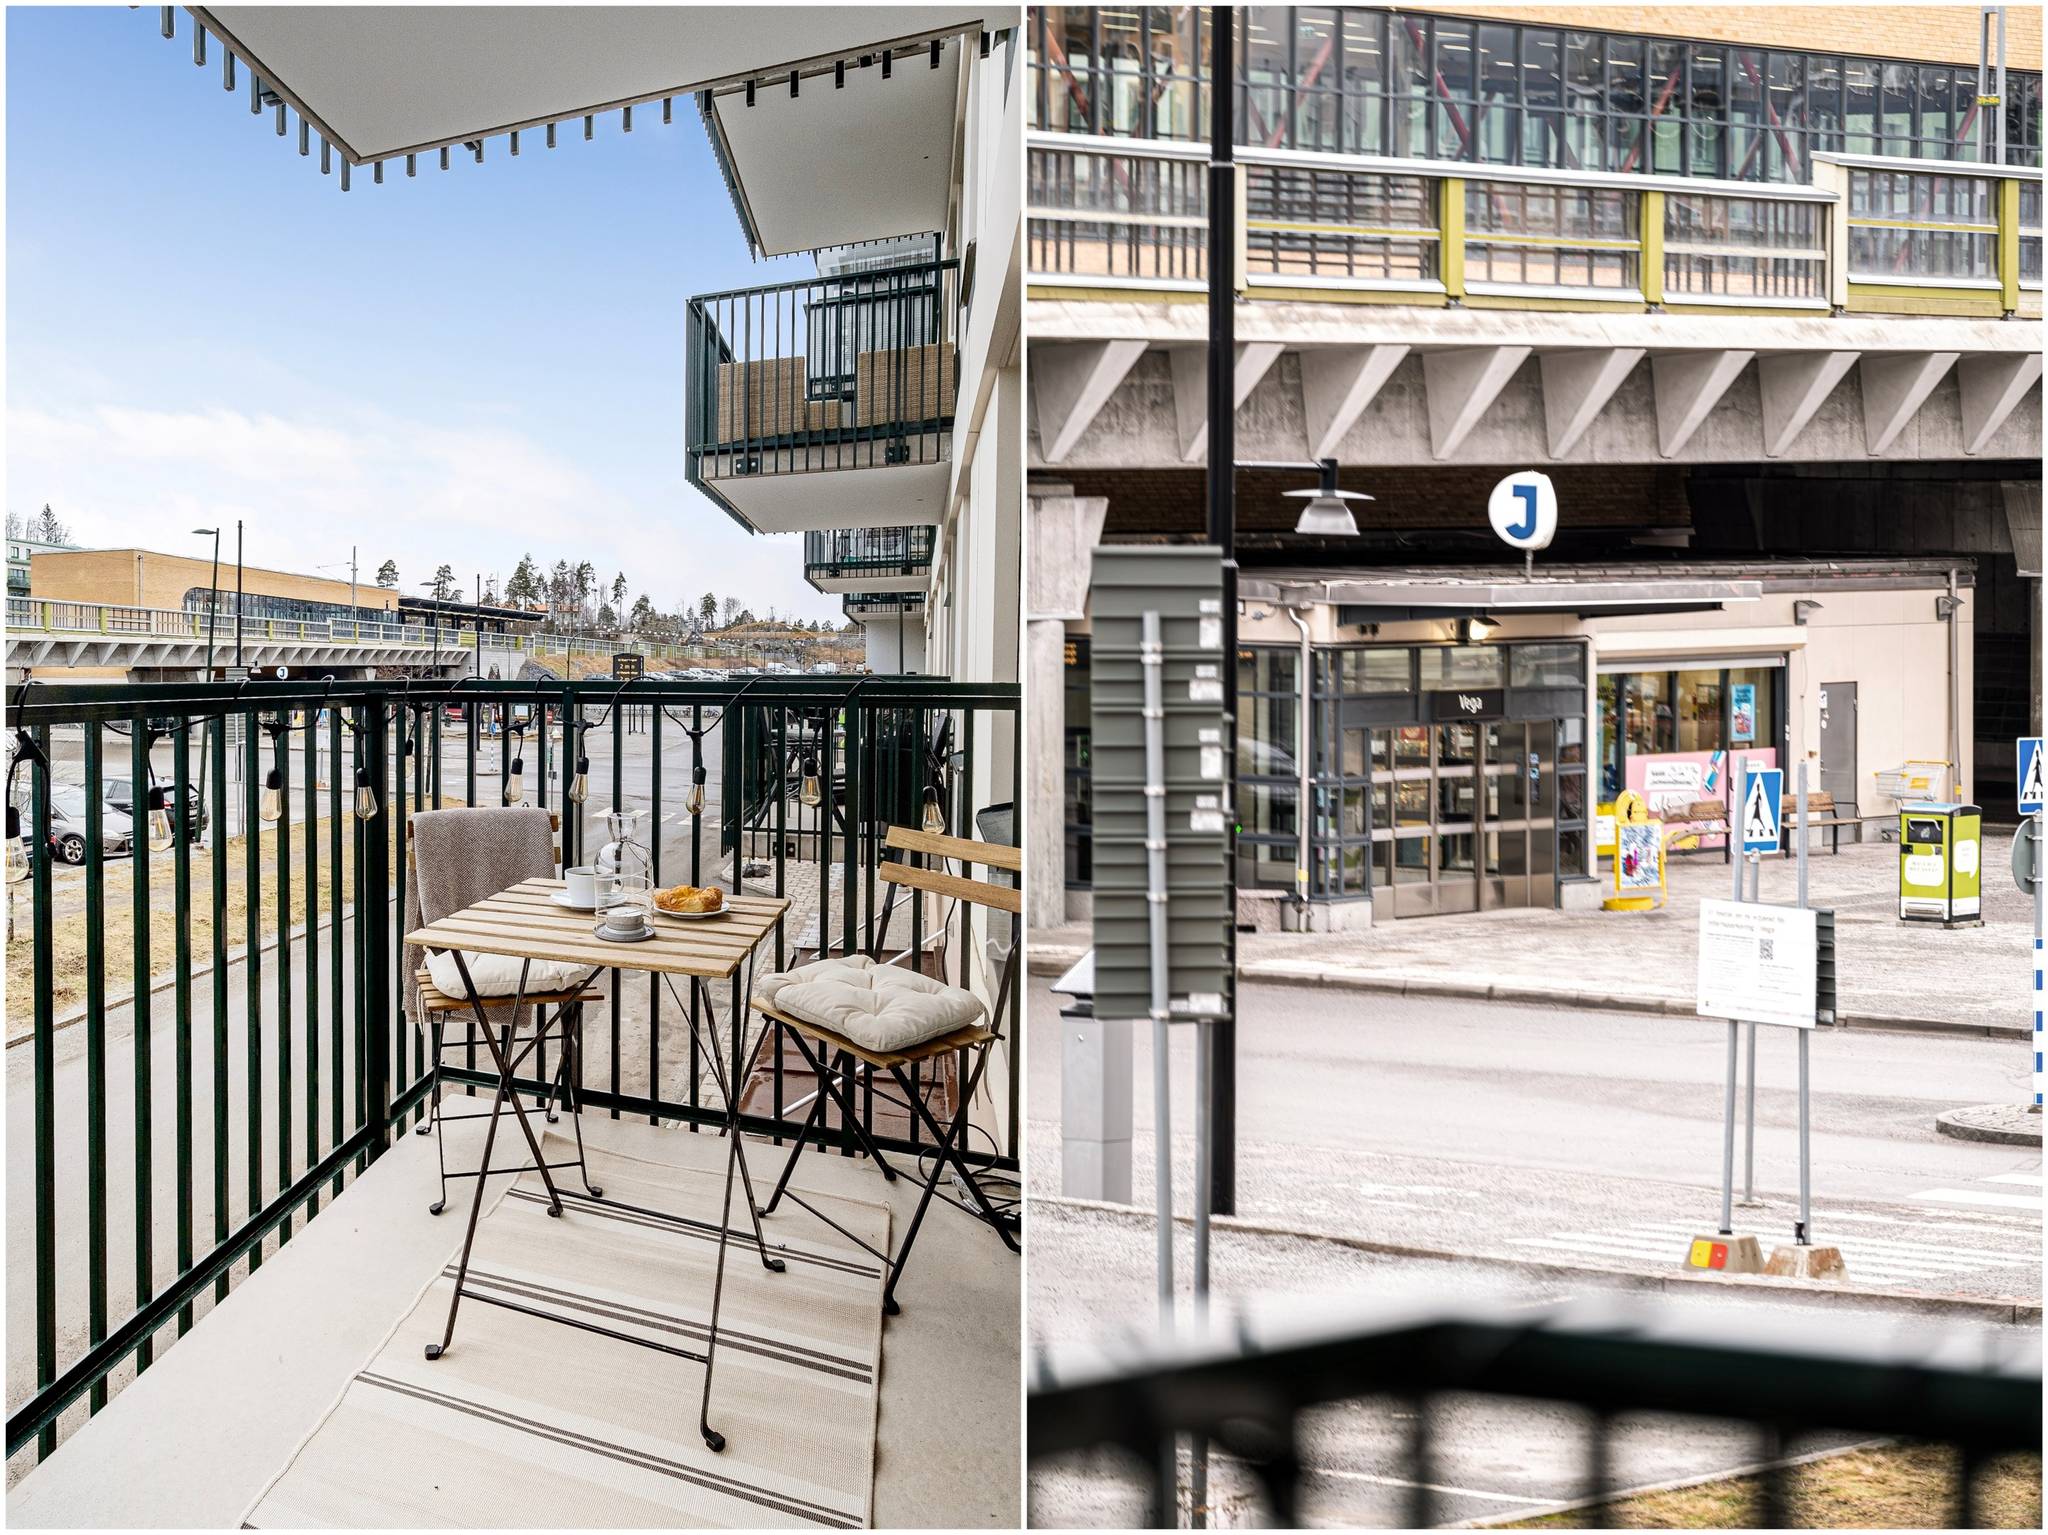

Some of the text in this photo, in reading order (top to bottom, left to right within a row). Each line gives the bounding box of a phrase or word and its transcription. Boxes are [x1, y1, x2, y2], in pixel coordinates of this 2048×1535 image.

[1505, 485, 1537, 540] J
[279, 668, 285, 678] J
[1458, 694, 1483, 714] Vega
